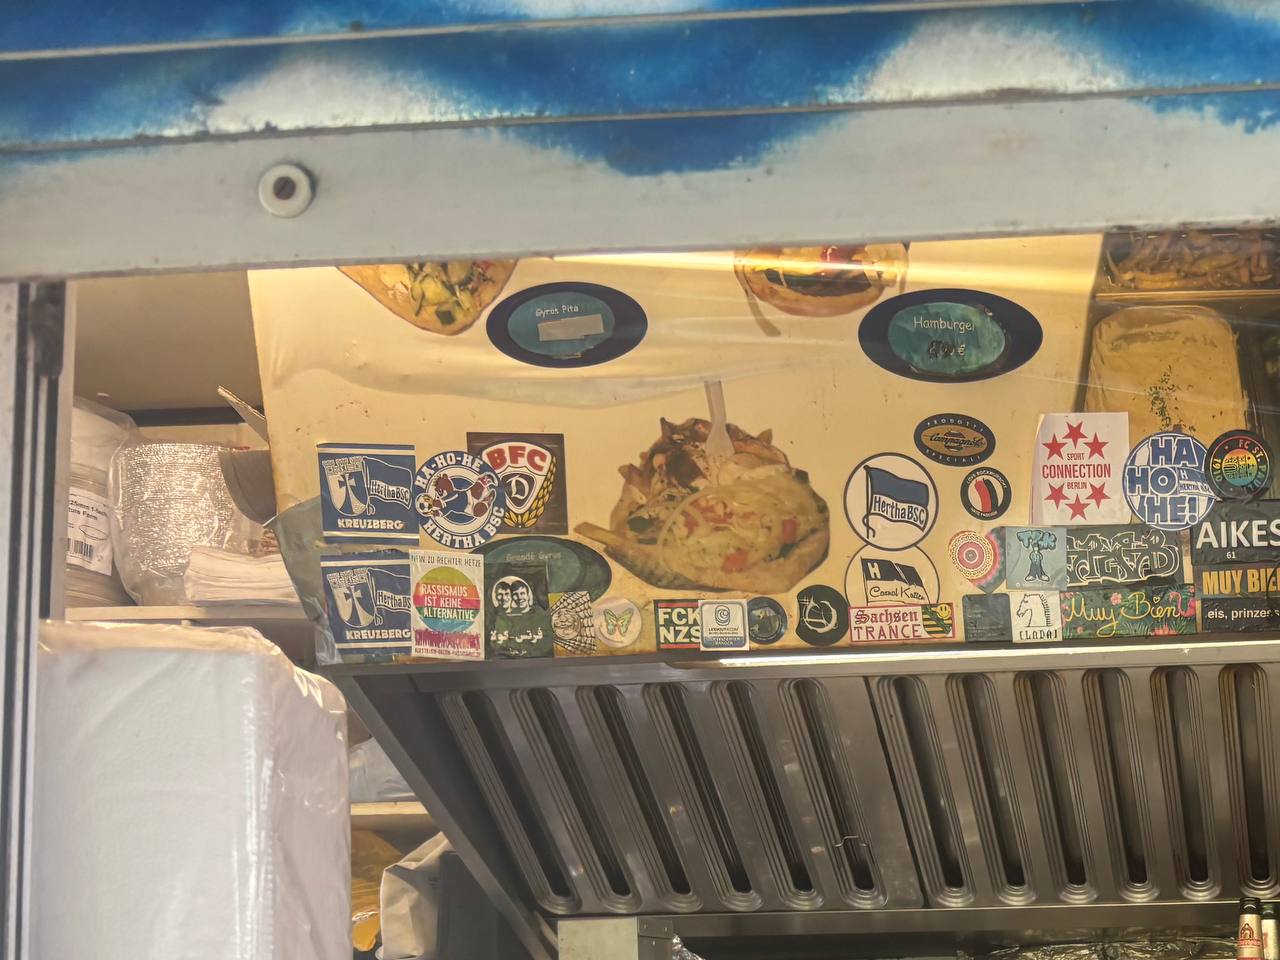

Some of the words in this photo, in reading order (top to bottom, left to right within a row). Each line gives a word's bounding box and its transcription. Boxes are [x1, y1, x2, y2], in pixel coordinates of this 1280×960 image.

[1149, 436, 1199, 467] HA
[1239, 439, 1251, 449] FC
[485, 445, 548, 473] BFC
[1042, 463, 1111, 479] CONNECTION
[1212, 458, 1223, 482] 1910
[1066, 481, 1088, 490] BERLIN
[1126, 465, 1178, 496] HO
[1144, 494, 1199, 525] HE!
[337, 518, 405, 530] KREUZBERG
[422, 518, 486, 549] HERTHA
[483, 505, 505, 537] BSC
[1226, 551, 1237, 559] 61
[867, 562, 881, 579] H
[421, 583, 468, 597] RASSISMUS
[1202, 569, 1243, 596] MUY
[424, 596, 437, 607] IST
[440, 597, 462, 609] KEINE
[423, 606, 475, 620] ALTERNATIVE
[658, 607, 700, 625] FCK
[854, 608, 919, 626] Sachsen
[1207, 608, 1228, 620] eis,
[345, 628, 411, 640] KREUZBERG
[660, 626, 701, 643] NZS
[853, 623, 922, 640] TRANCE
